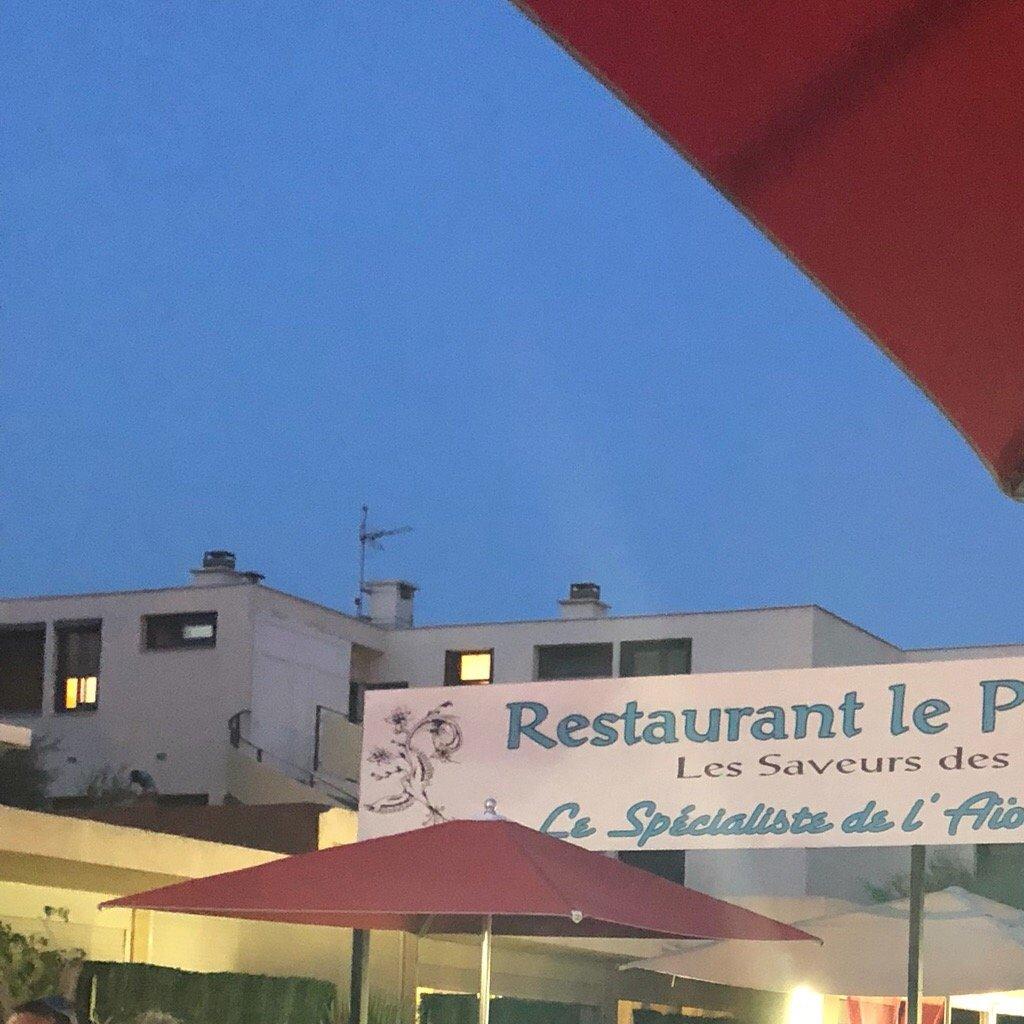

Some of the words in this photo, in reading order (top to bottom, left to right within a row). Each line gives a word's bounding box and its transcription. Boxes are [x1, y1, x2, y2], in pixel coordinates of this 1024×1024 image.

[506, 691, 865, 750] Restaurant
[888, 683, 951, 736] le
[676, 756, 743, 779] Les
[758, 753, 922, 777] Saveurs
[938, 746, 1010, 770] des
[607, 800, 835, 848] Spécialiste
[841, 800, 895, 834] de
